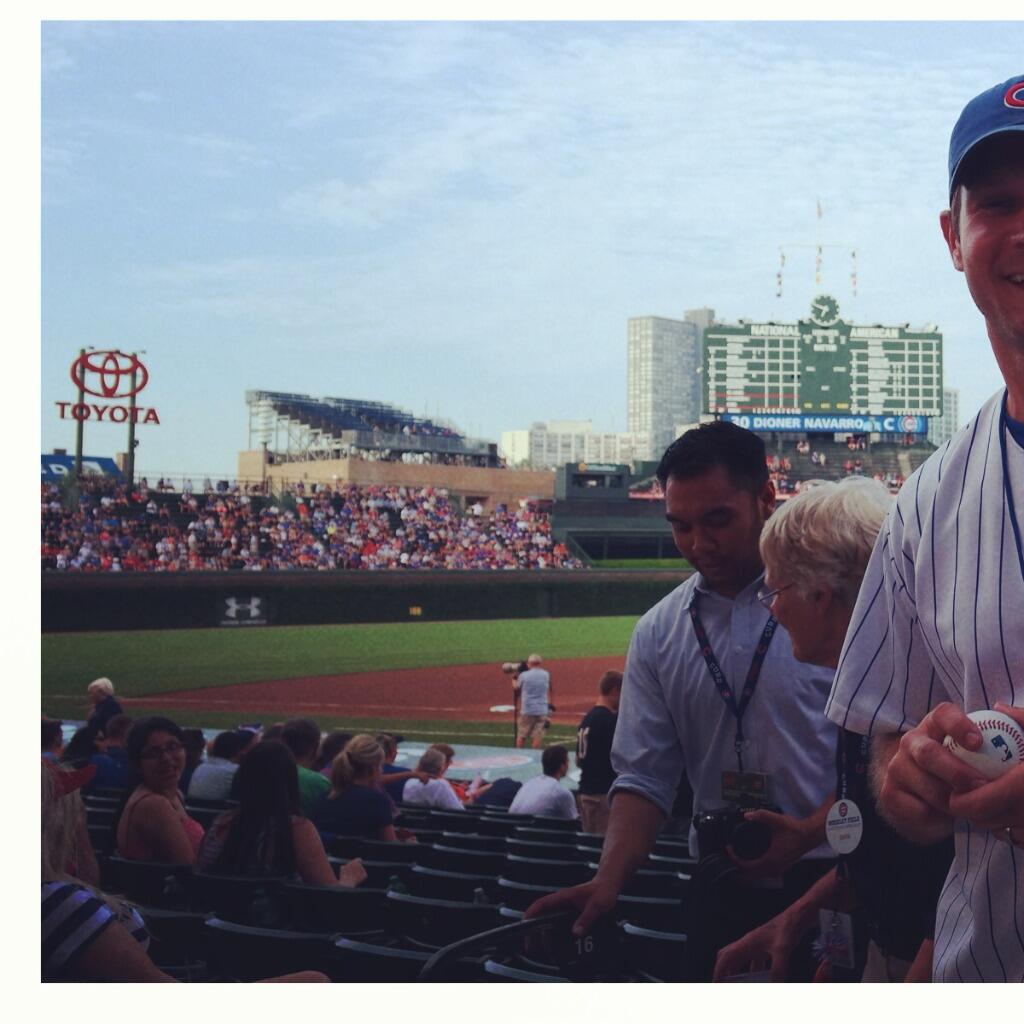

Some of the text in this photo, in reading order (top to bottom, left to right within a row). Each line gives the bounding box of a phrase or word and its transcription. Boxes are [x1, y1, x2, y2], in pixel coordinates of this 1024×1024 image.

[750, 325, 800, 337] NATIONAL
[849, 327, 899, 338] AMERICAN
[55, 402, 160, 425] TOYOTA
[753, 416, 800, 430] DIONER
[804, 416, 864, 430] NAVARRO
[883, 417, 896, 431] C
[574, 935, 594, 955] 16
